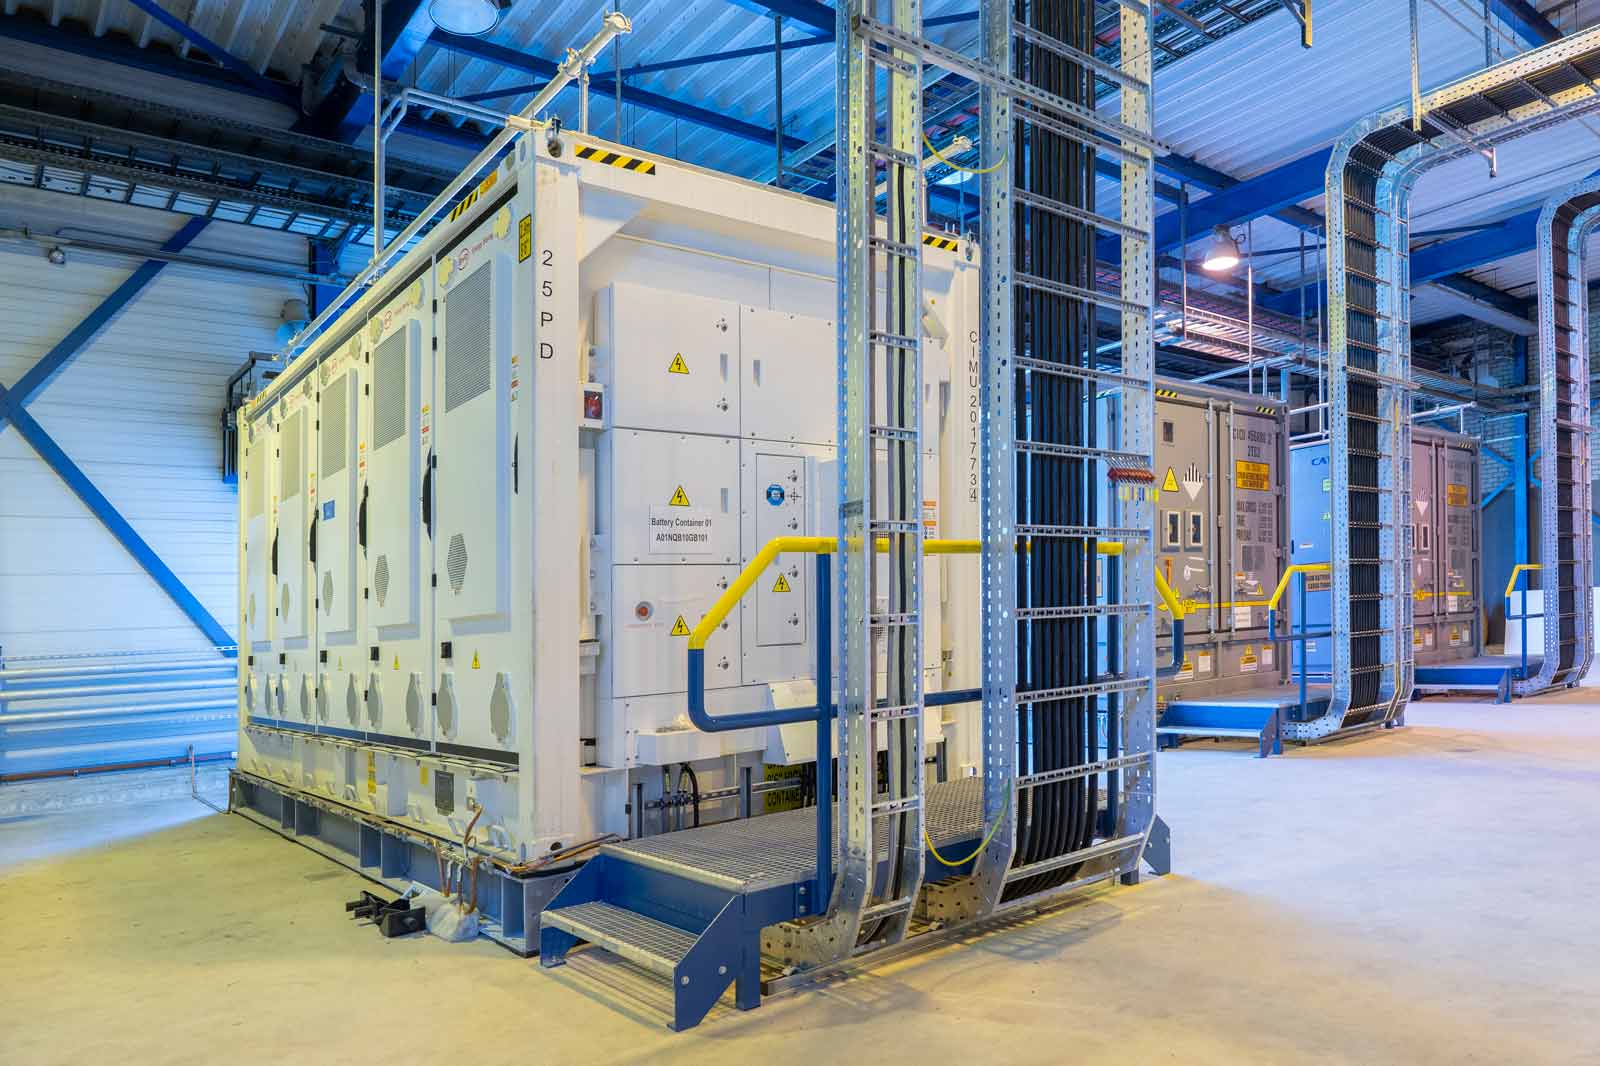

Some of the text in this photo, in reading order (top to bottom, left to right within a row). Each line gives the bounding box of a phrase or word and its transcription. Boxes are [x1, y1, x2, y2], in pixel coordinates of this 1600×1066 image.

[651, 518, 712, 528] Battery Container 01
